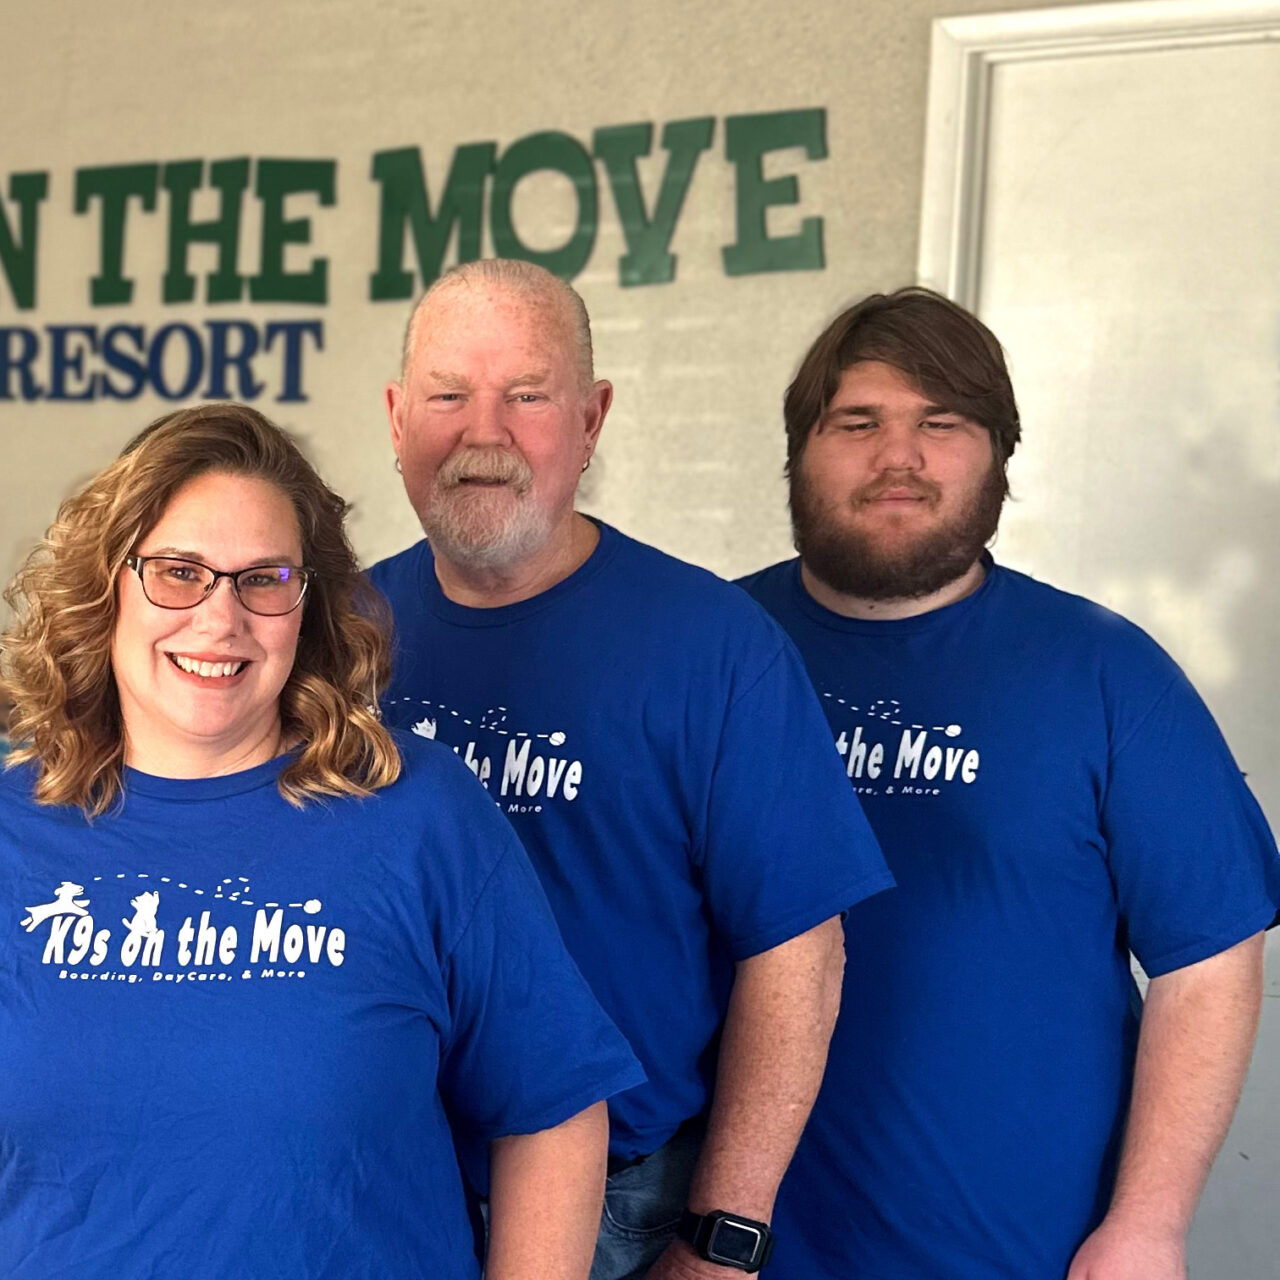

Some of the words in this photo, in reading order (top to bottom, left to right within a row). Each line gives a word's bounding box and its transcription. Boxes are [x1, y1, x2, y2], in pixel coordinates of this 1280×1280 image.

[74, 157, 336, 306] THE
[370, 107, 827, 302] MOVE
[500, 739, 582, 801] Move
[893, 729, 979, 784] Move
[508, 803, 543, 813] More
[885, 786, 894, 794] &
[901, 786, 940, 795] More
[42, 915, 111, 966] K9s
[120, 928, 165, 968] on
[177, 911, 238, 967] the
[250, 909, 346, 967] Move
[59, 970, 143, 983] Boarding,
[241, 969, 252, 980] &
[261, 968, 306, 979] More
